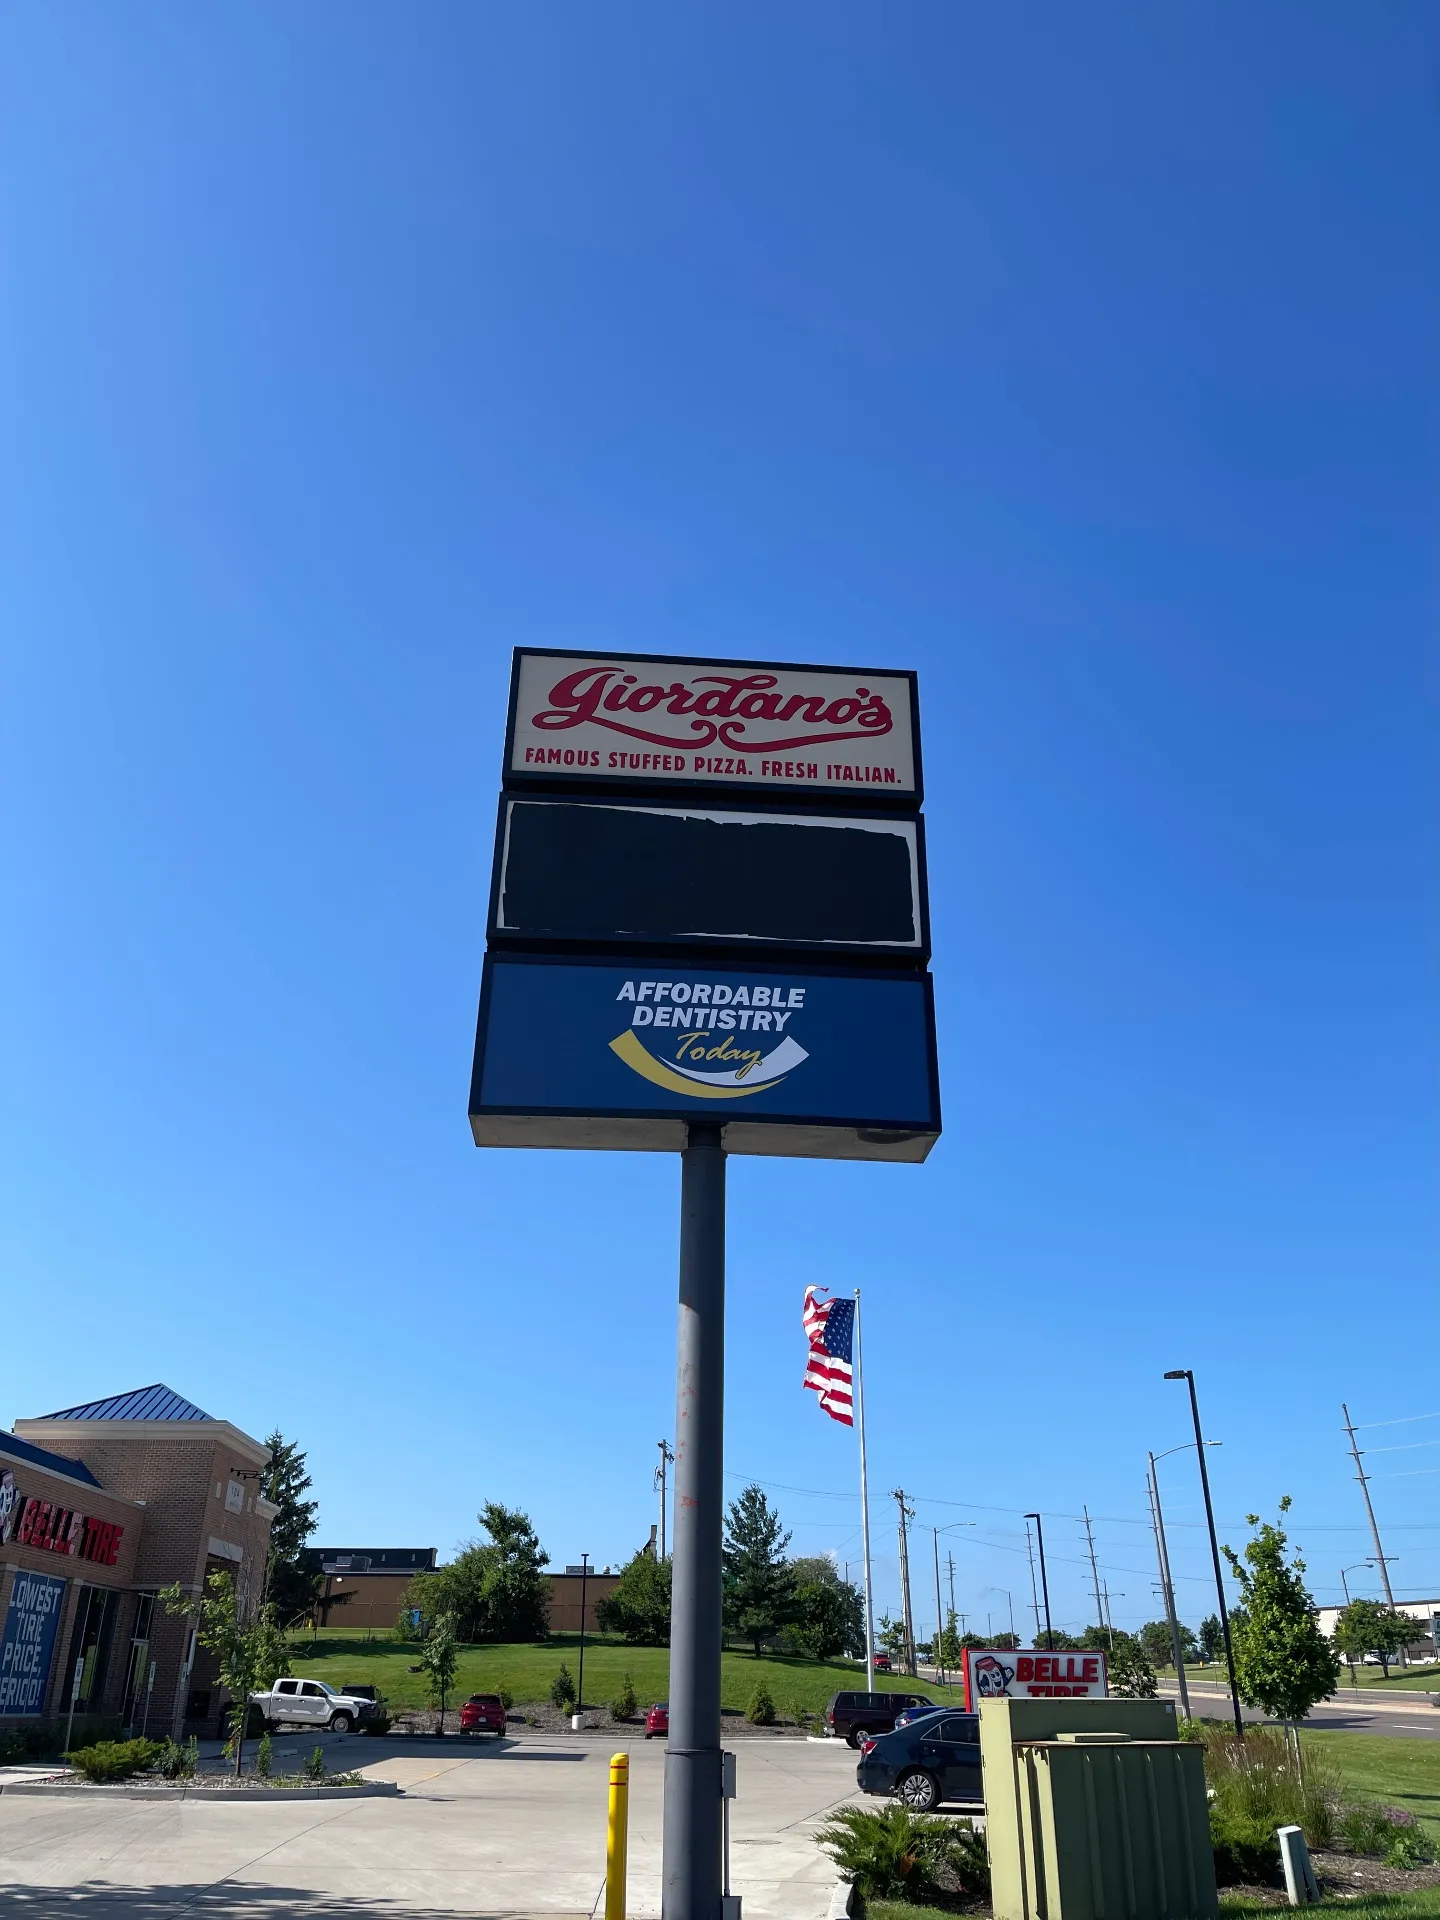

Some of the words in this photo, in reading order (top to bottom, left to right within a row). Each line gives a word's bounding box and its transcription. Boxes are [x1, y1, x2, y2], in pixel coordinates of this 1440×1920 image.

[532, 667, 893, 753] Giordano's
[525, 747, 600, 767] FAMOUS
[608, 752, 686, 771] STUFFED
[694, 756, 753, 775] PIZZA.
[761, 760, 818, 778] FRESH
[826, 764, 902, 783] ITALIAN.
[616, 981, 806, 1008] AFFORDABLE
[631, 1005, 792, 1031] DENTISTRY
[674, 1031, 763, 1080] Today
[16, 1498, 83, 1555] BELLE
[82, 1517, 125, 1566] TIRE
[9, 1579, 61, 1614] LOWEST
[17, 1612, 45, 1642] TIRE
[2, 1642, 42, 1677] PRICE,
[1015, 1658, 1099, 1682] BELLE
[0, 1676, 42, 1706] ERIOD!
